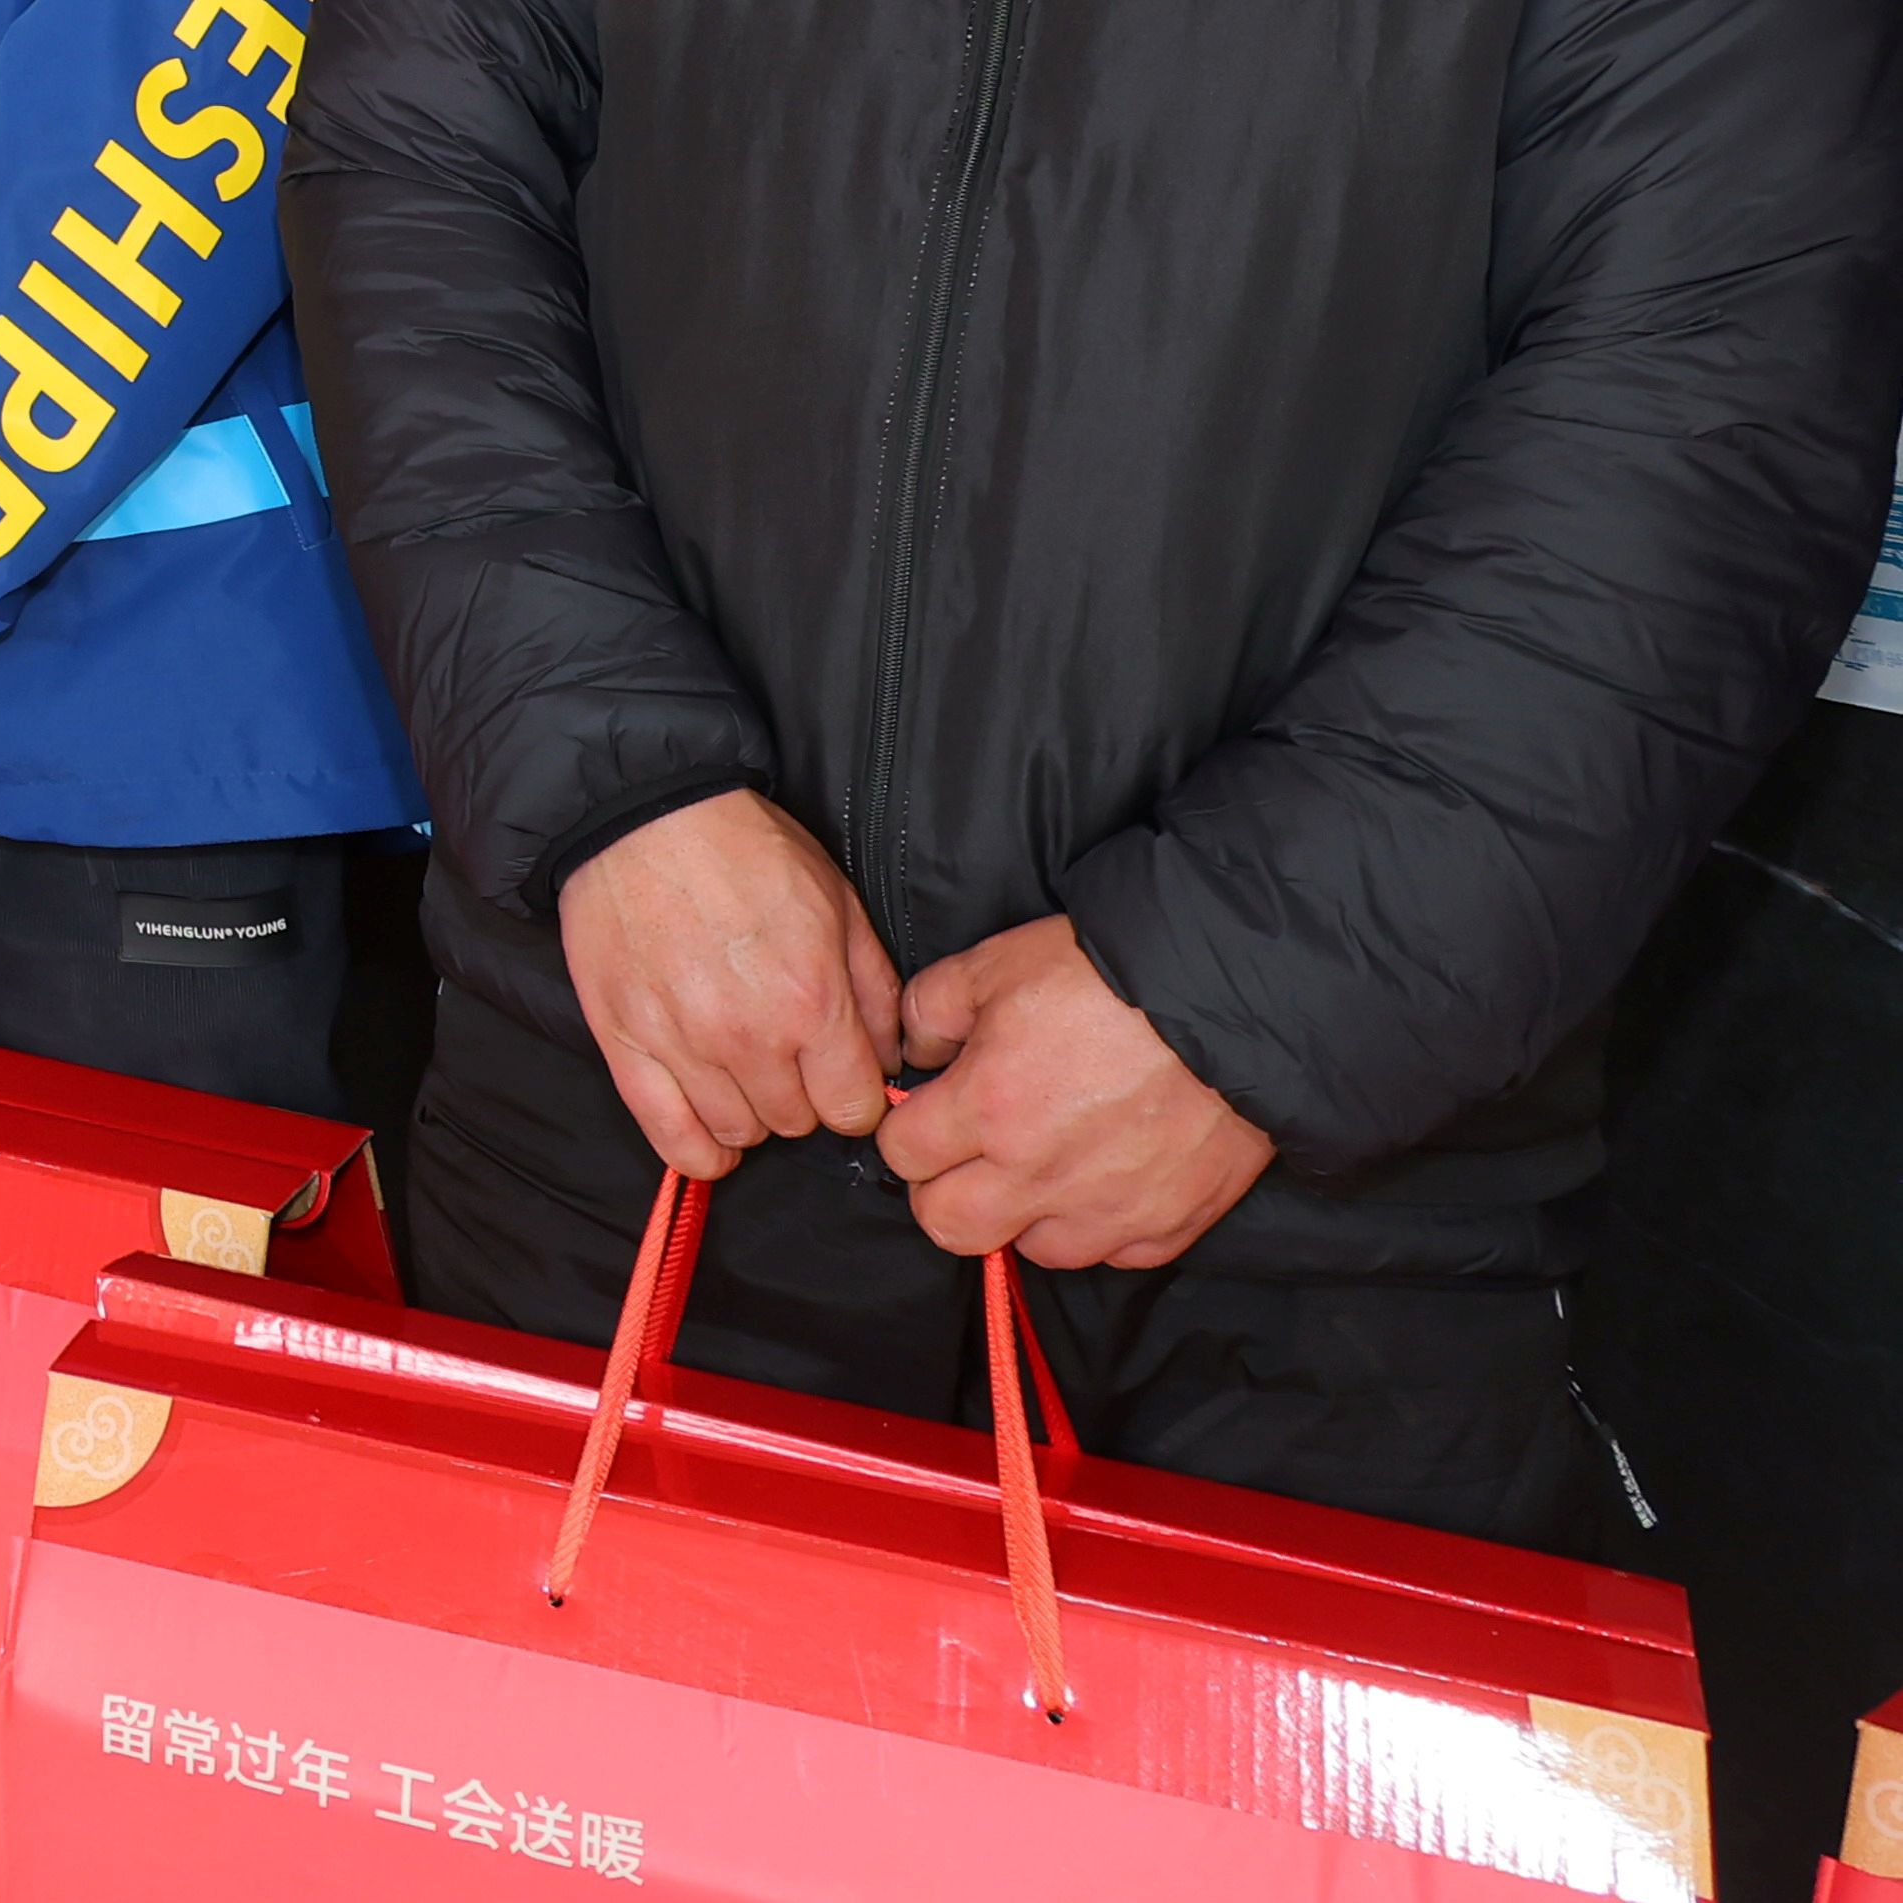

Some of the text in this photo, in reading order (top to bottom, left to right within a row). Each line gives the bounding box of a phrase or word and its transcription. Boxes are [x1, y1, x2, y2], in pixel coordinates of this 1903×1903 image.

[235, 917, 288, 940] YOUNG
[100, 1692, 646, 1886] 留常过年 工会送暖
